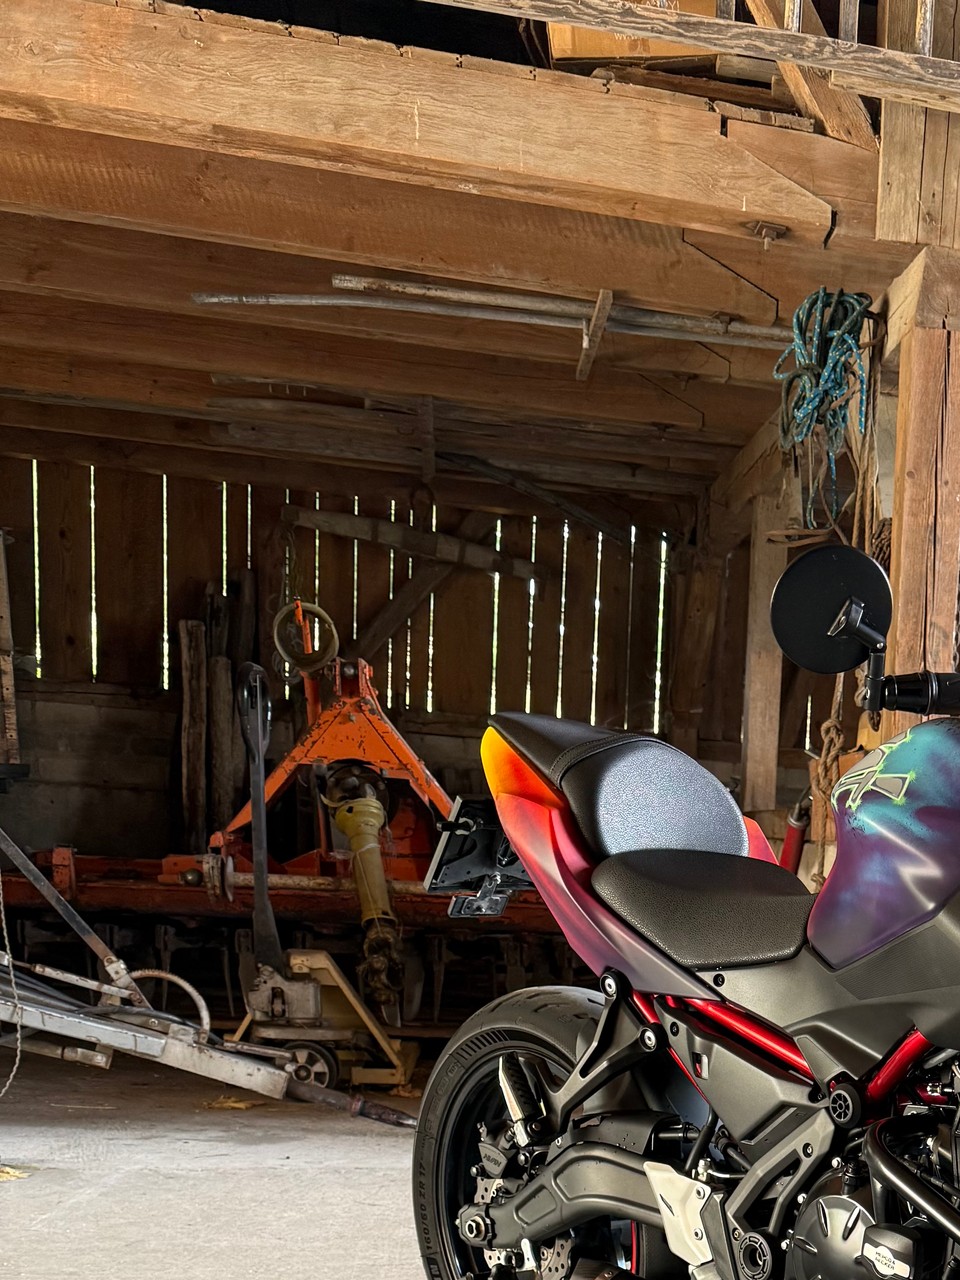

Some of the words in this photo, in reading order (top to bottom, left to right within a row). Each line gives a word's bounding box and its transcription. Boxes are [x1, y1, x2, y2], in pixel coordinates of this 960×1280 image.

[418, 1161, 427, 1177] 17
[418, 1181, 427, 1200] ZR
[419, 1203, 433, 1251] 160/60
